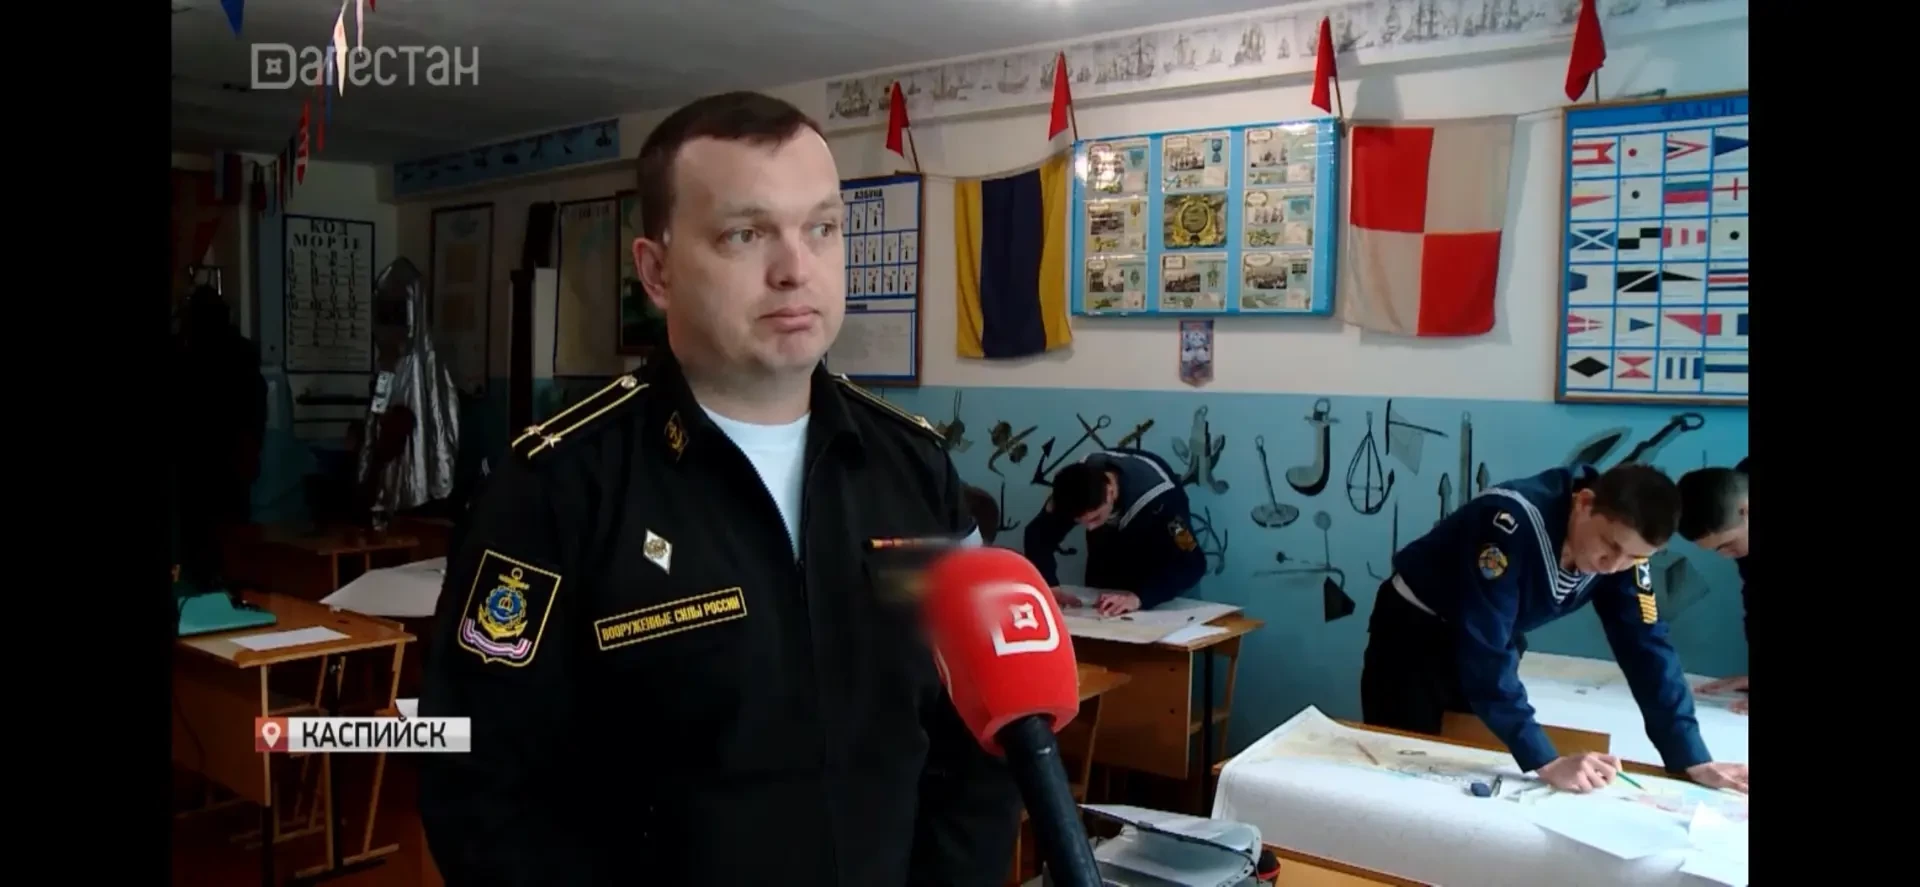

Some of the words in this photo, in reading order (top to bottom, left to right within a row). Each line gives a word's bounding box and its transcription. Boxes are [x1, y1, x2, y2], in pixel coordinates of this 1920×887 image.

[310, 219, 348, 236] КОД
[601, 612, 675, 641] ВООРУЖЕННЫЕ
[674, 604, 703, 623] СИЛЫ
[703, 595, 741, 616] РОССИИ
